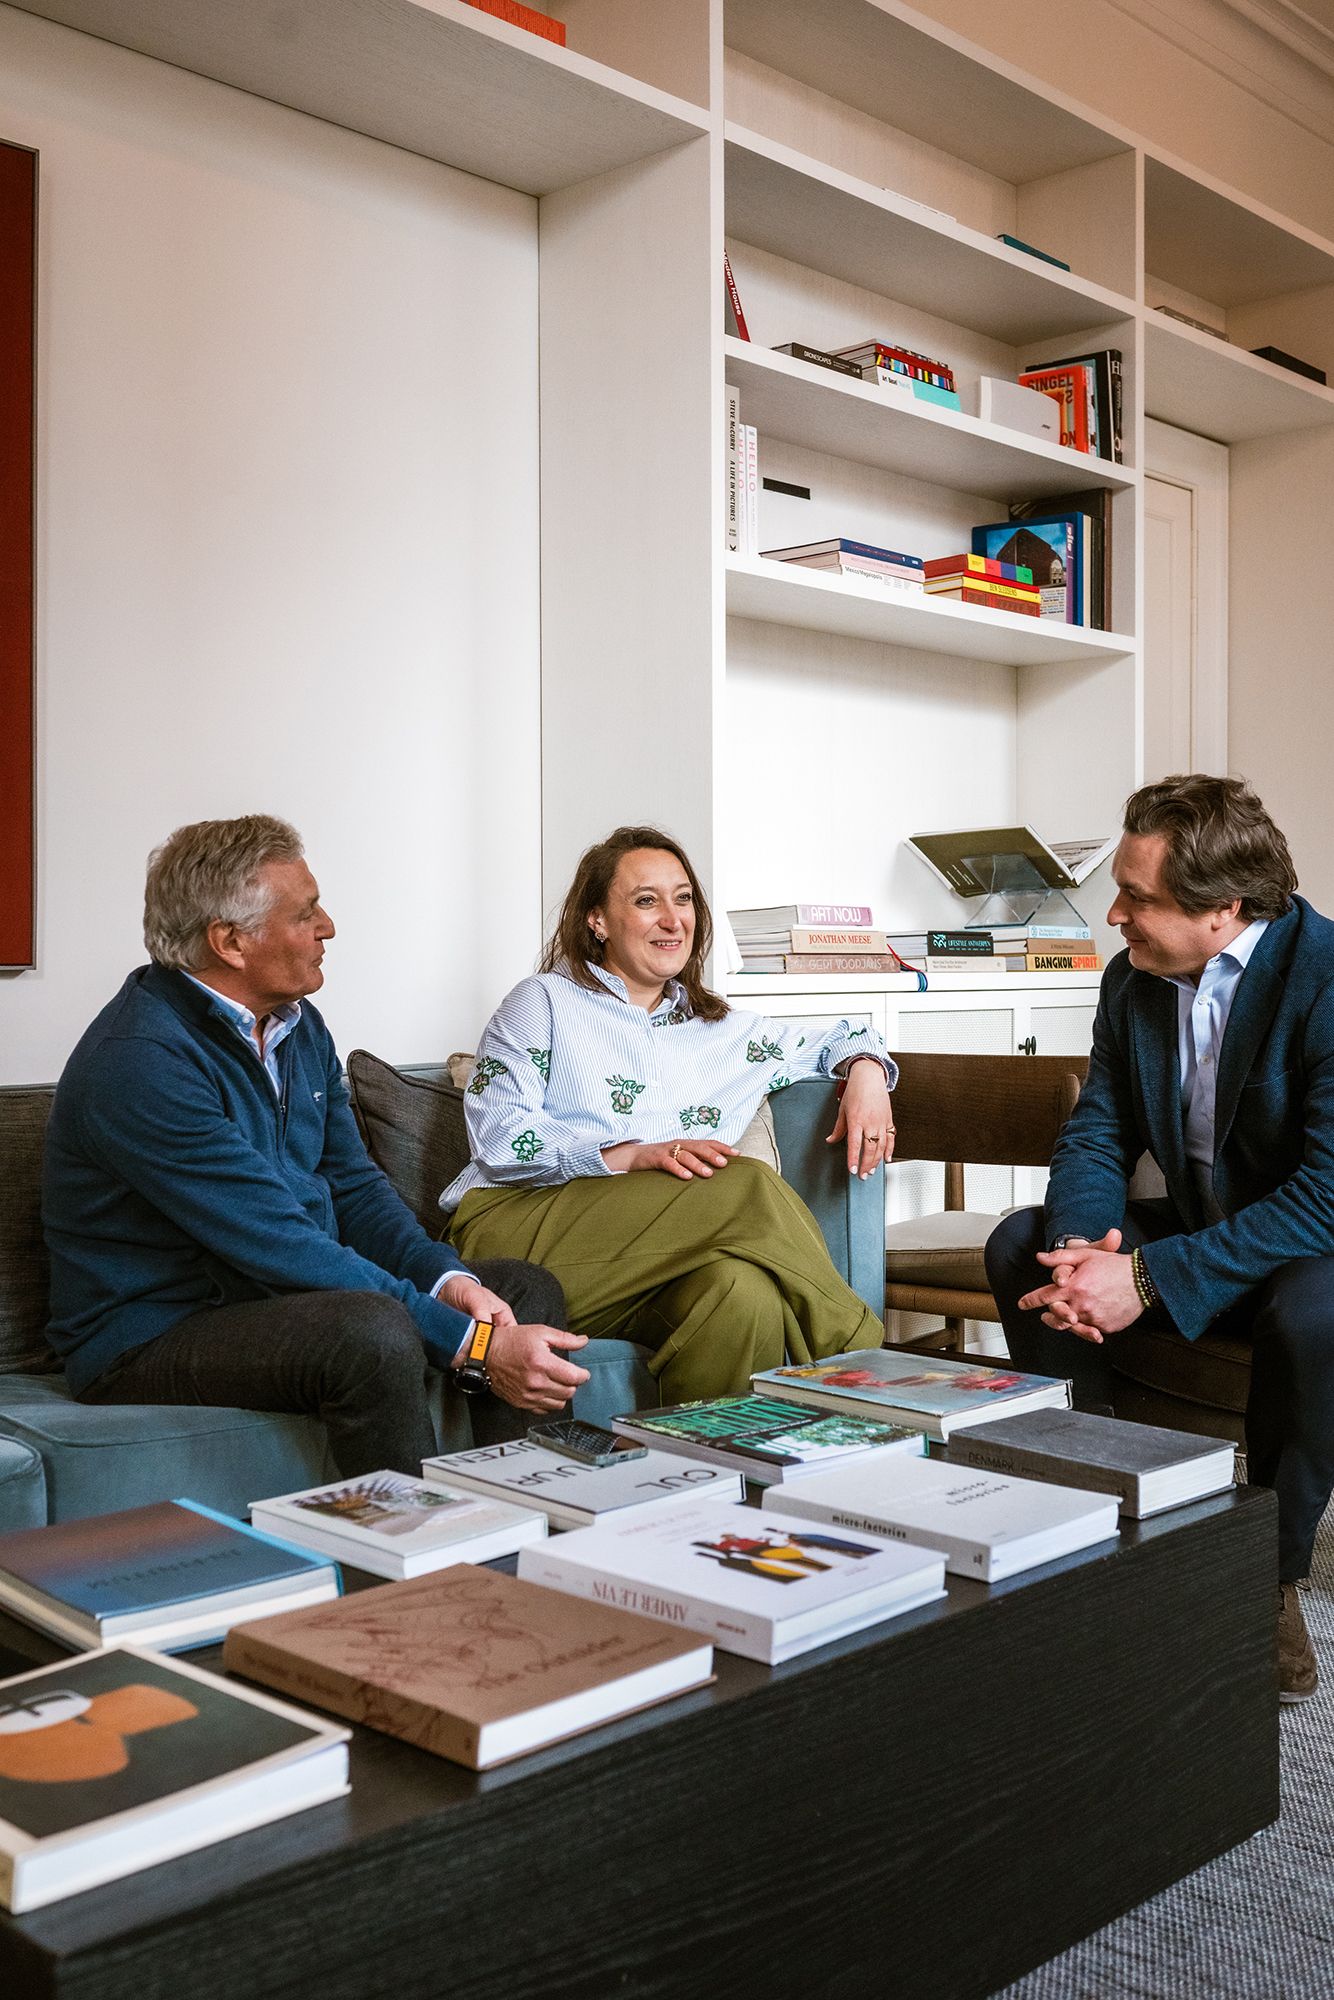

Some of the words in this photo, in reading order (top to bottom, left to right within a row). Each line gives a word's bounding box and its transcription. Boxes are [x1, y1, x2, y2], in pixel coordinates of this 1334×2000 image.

[731, 287, 742, 315] House
[1027, 372, 1073, 391] SINGEL
[729, 481, 736, 489] IN
[811, 906, 832, 922] ART
[834, 906, 862, 923] NOW
[809, 934, 847, 945] JONATHAN
[848, 935, 872, 945] MEESE
[440, 1440, 538, 1468] UIZEN
[968, 1452, 1015, 1472] DENMARK
[505, 1463, 600, 1488] UUR
[635, 1468, 718, 1491] CUL
[832, 1514, 906, 1539] micro-factories
[592, 1580, 616, 1601] VIN
[620, 1587, 638, 1608] LE
[641, 1591, 689, 1622] AIMER
